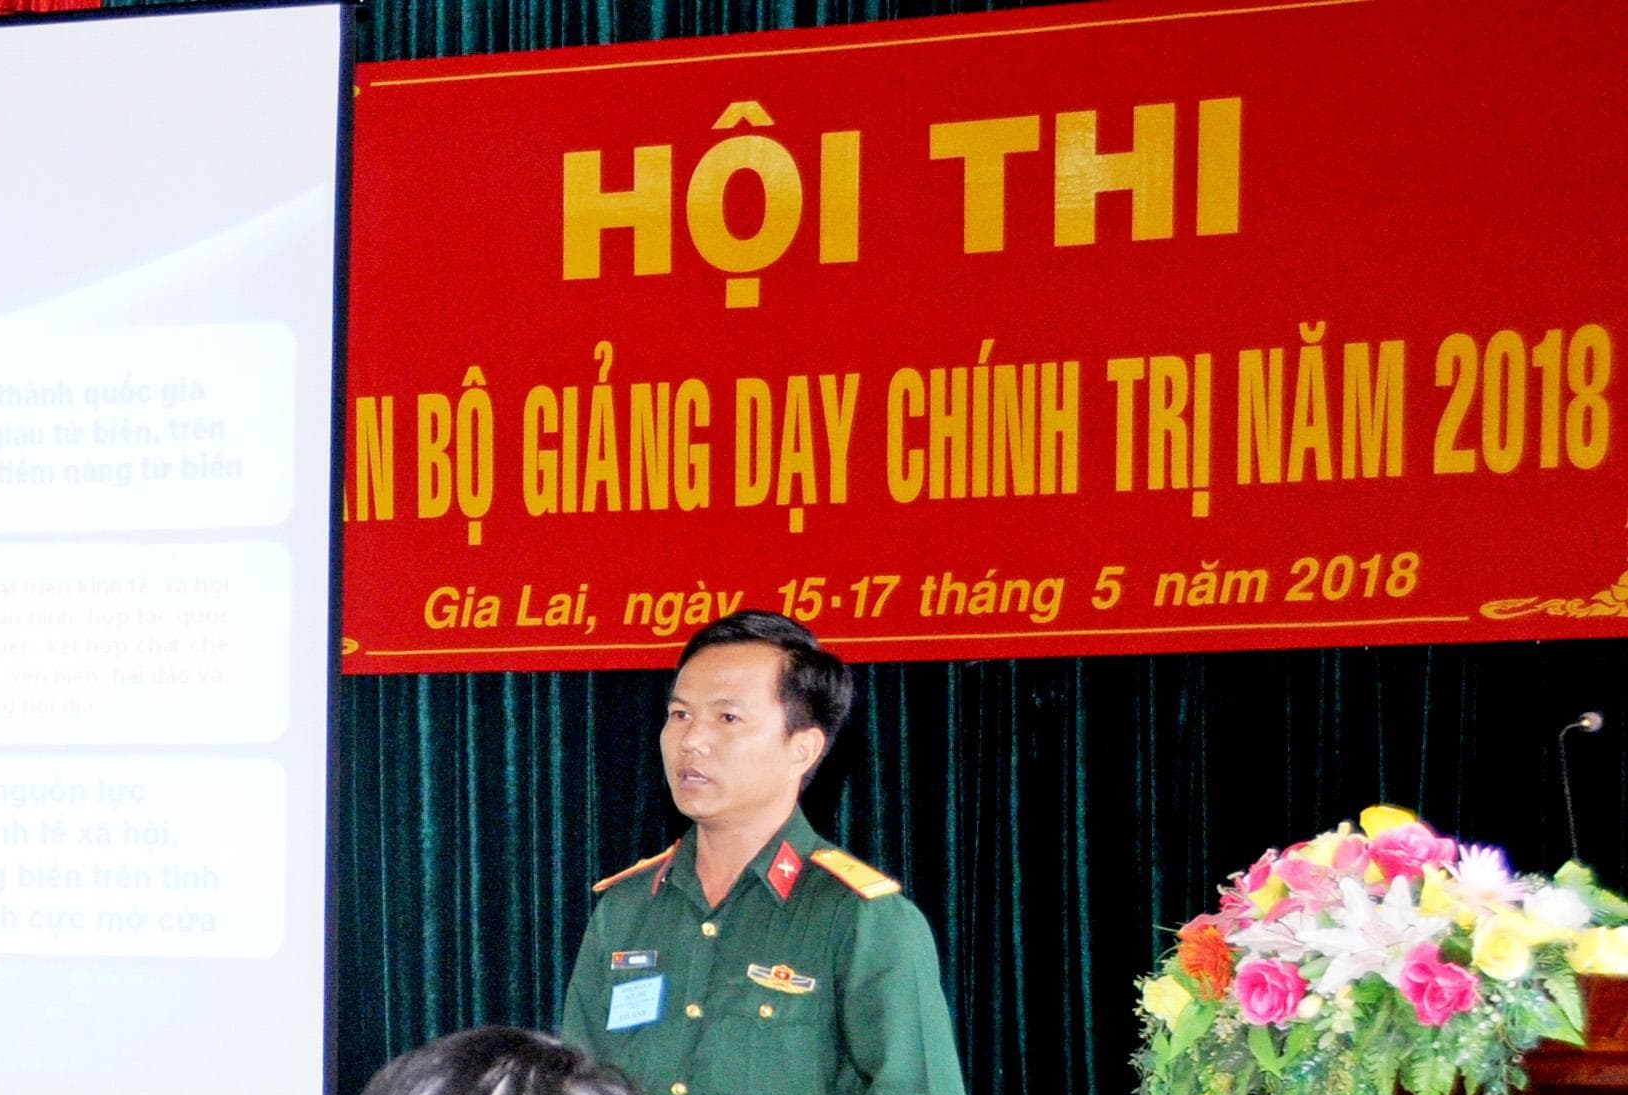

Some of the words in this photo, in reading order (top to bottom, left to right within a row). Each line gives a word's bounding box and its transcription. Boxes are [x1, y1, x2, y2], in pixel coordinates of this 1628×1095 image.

[563, 101, 860, 308] HỘI
[930, 98, 1241, 253] THI
[417, 366, 494, 545] BỘ
[523, 341, 710, 516] GIẢNG
[735, 374, 859, 533] DẠY
[887, 339, 1080, 503] CHÍNH
[1107, 354, 1212, 518] TRỊ
[1237, 321, 1405, 484] NĂM
[1433, 325, 1612, 474] 2018
[425, 586, 501, 629] Gia
[517, 584, 597, 634] Lai,
[921, 569, 1065, 624] tháng
[1091, 566, 1125, 610] 5
[1155, 560, 1269, 606] năm
[1284, 552, 1420, 602] 2018
